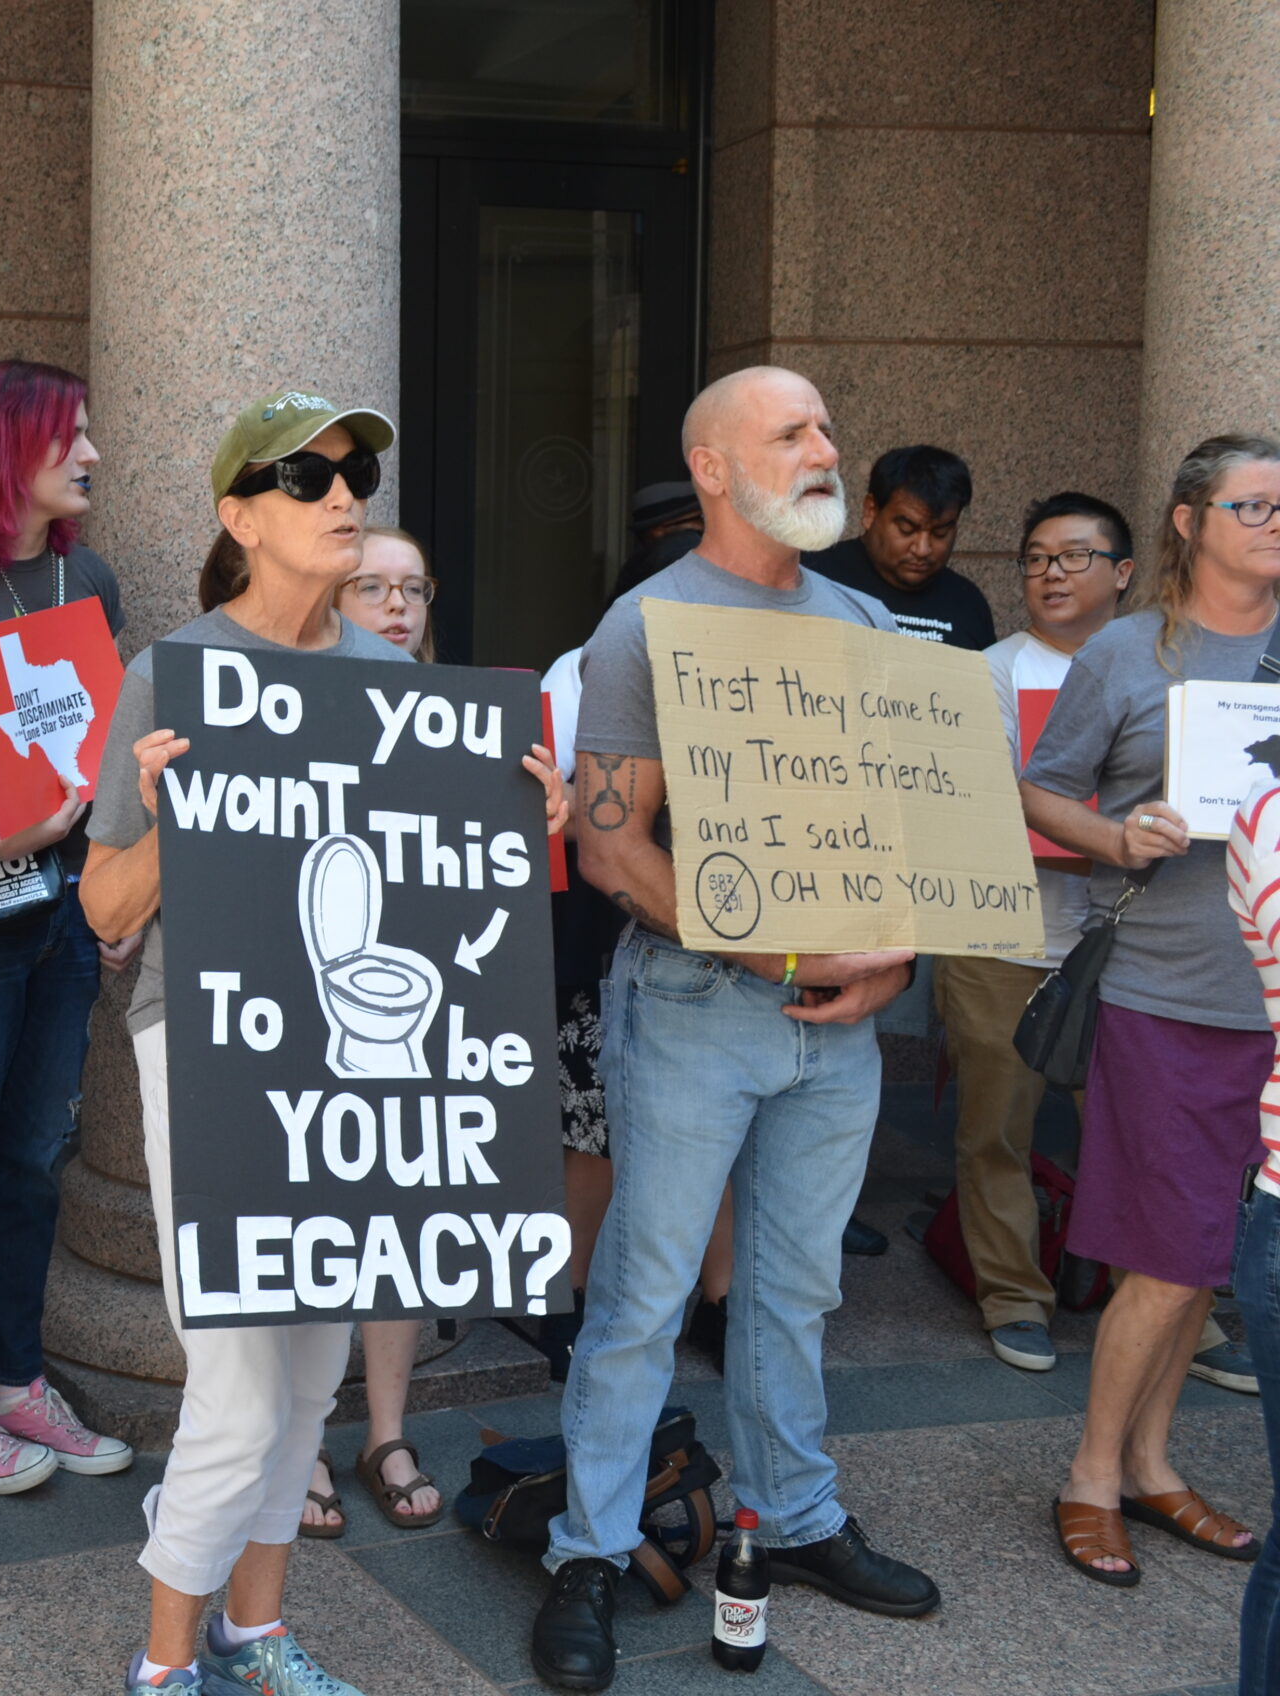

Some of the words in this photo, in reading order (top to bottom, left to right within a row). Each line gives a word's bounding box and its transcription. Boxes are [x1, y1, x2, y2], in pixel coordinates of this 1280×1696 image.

[890, 613, 953, 632] ocumented
[14, 688, 40, 710] DON'T
[18, 692, 87, 727] DISCRIMINATE
[202, 647, 303, 735] Do
[365, 688, 502, 764] you
[673, 651, 759, 714] First
[776, 666, 846, 734] they
[860, 691, 922, 722] came
[928, 691, 963, 727] for
[1217, 700, 1231, 710] My
[22, 727, 41, 742] Lone
[40, 721, 57, 735] Star
[58, 712, 84, 728] State
[1253, 714, 1280, 723] huma
[687, 744, 731, 802] my
[746, 739, 848, 786] Trans
[1199, 796, 1224, 805] Don't
[1227, 798, 1242, 806] tak
[698, 817, 749, 844] and
[761, 814, 786, 847] I
[368, 810, 531, 890] This
[771, 870, 820, 902] OH
[842, 872, 883, 902] NO
[896, 872, 954, 906] YOU
[970, 878, 1035, 912] DON'T
[199, 971, 283, 1052] To
[447, 1004, 534, 1087] be
[265, 1090, 500, 1187] YOUR
[178, 1212, 572, 1318] LEGACY?
[723, 1606, 754, 1624] Pepper
[733, 1606, 746, 1615] Dr
